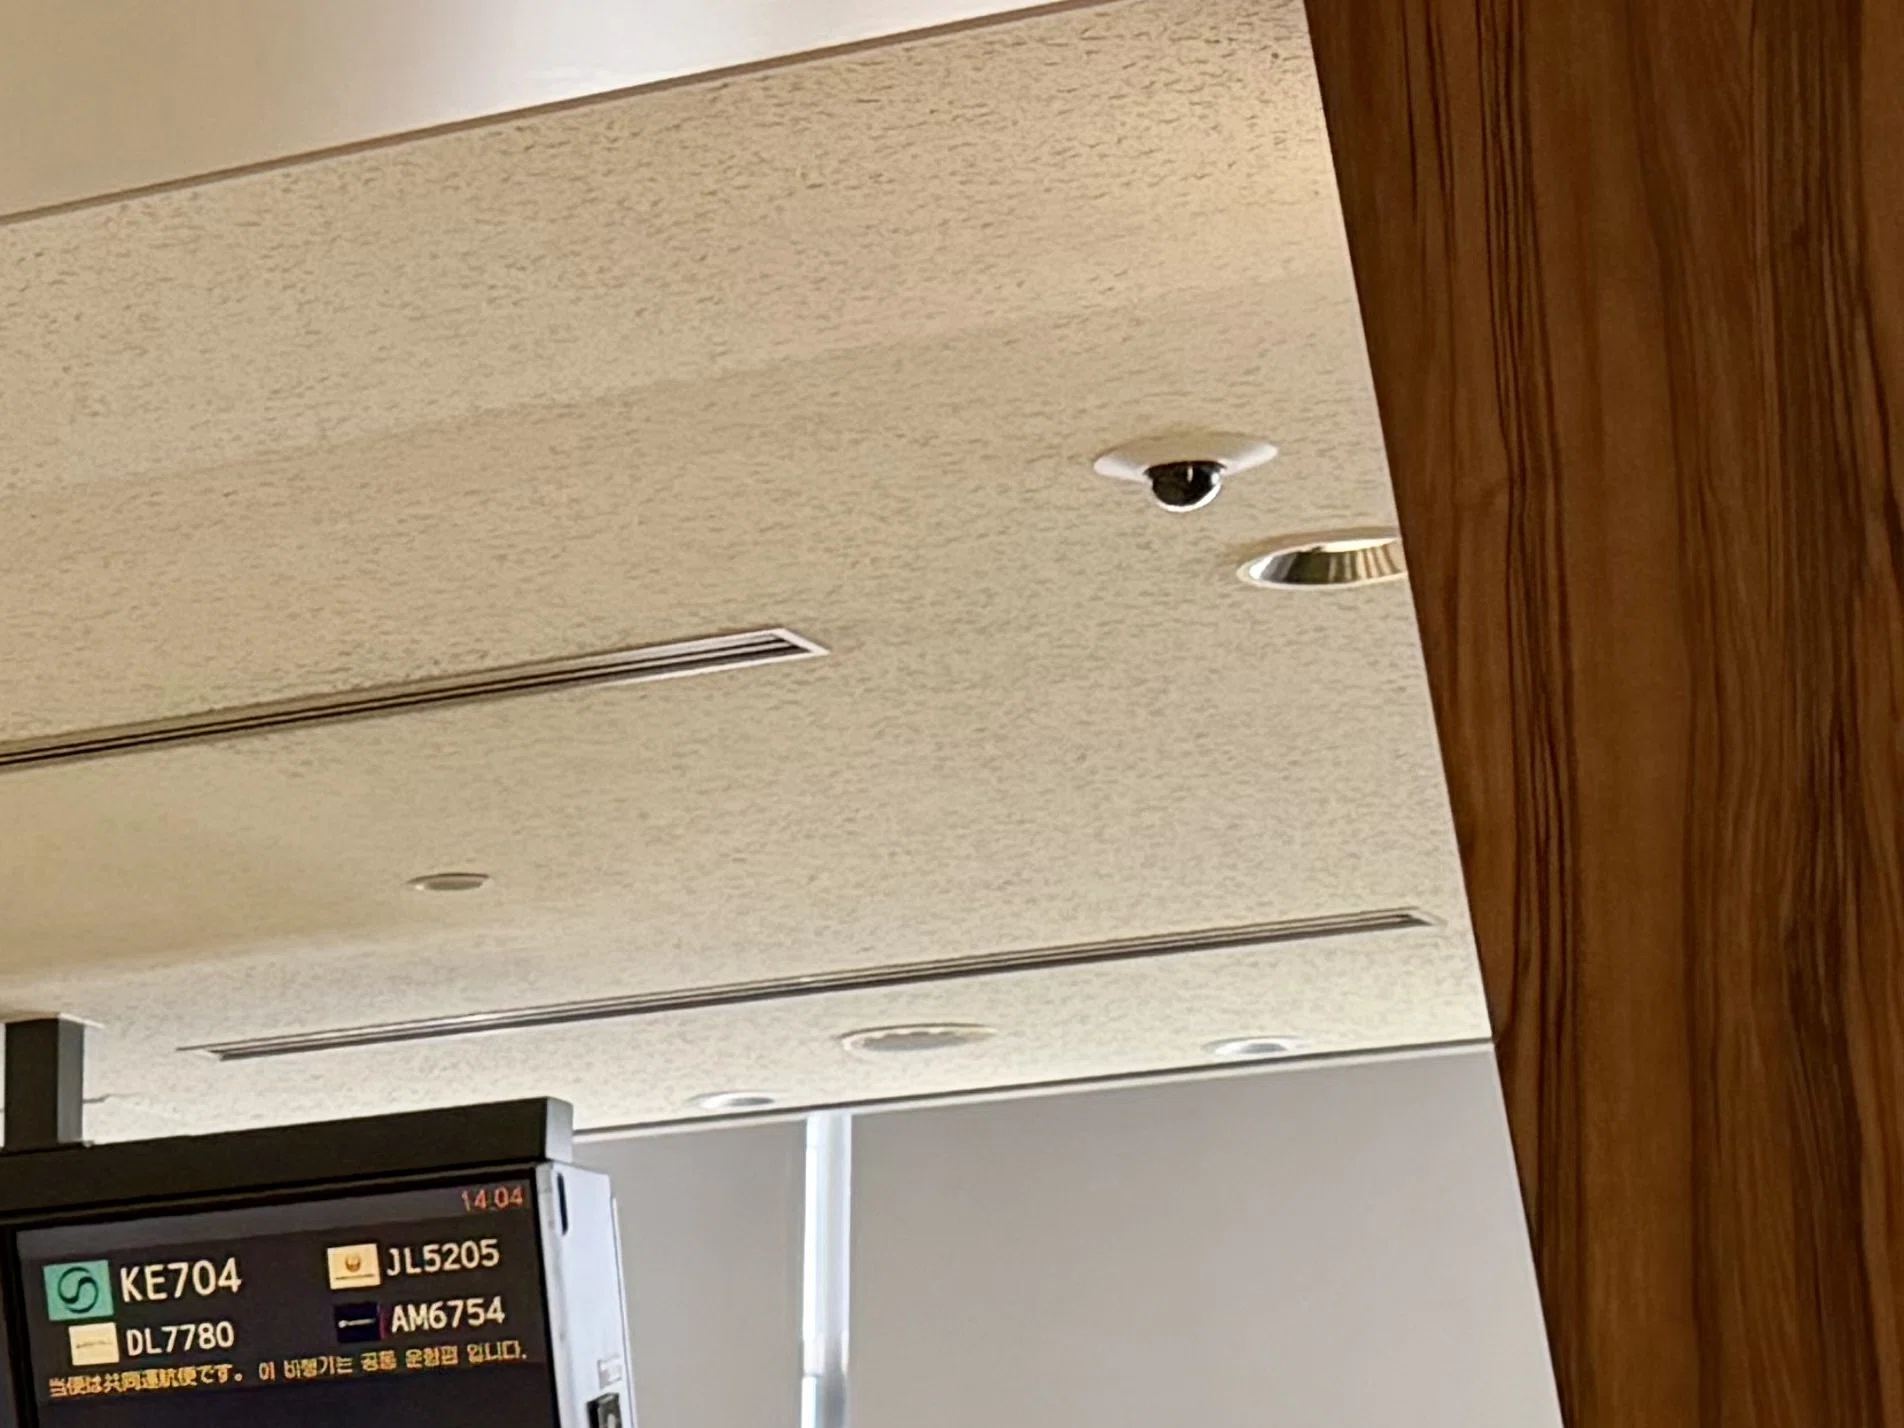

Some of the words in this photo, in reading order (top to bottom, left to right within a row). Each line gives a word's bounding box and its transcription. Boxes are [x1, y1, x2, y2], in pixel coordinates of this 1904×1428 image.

[386, 1238, 500, 1277] JL5205
[120, 1257, 242, 1302] KE704
[392, 1296, 505, 1334] AM6754
[125, 1321, 234, 1357] DL7780
[258, 1360, 276, 1382] 이
